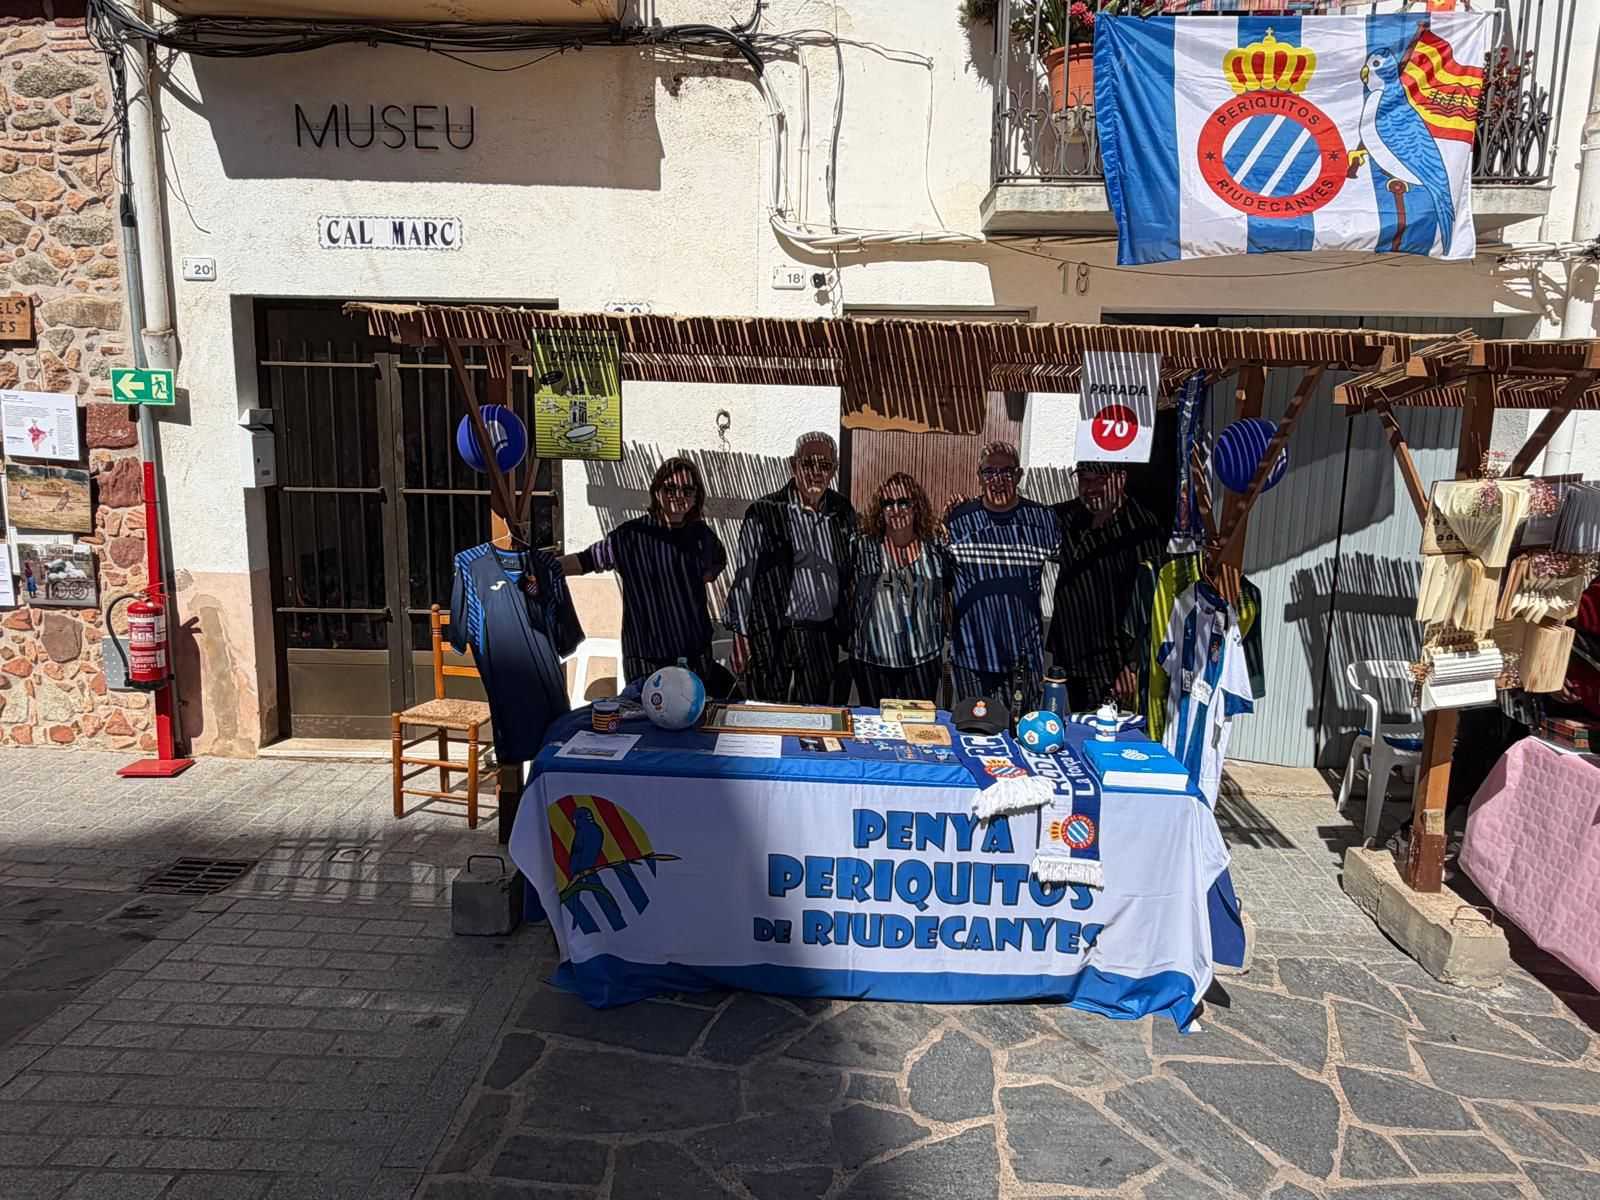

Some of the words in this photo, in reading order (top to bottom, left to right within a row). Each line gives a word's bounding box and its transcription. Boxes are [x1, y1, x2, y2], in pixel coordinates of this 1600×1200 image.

[1217, 96, 1320, 126] PERIQUITOS
[294, 103, 475, 150] MUSEU
[1217, 179, 1334, 212] RIUDECANYES
[326, 219, 373, 245] CAL
[391, 220, 454, 246] MARC
[193, 264, 210, 275] 20
[787, 272, 801, 284] 18
[1056, 261, 1090, 296] 18
[1089, 383, 1149, 396] PARADA
[1101, 419, 1129, 438] 70
[852, 808, 1015, 853] PENYA
[753, 916, 792, 944] DE
